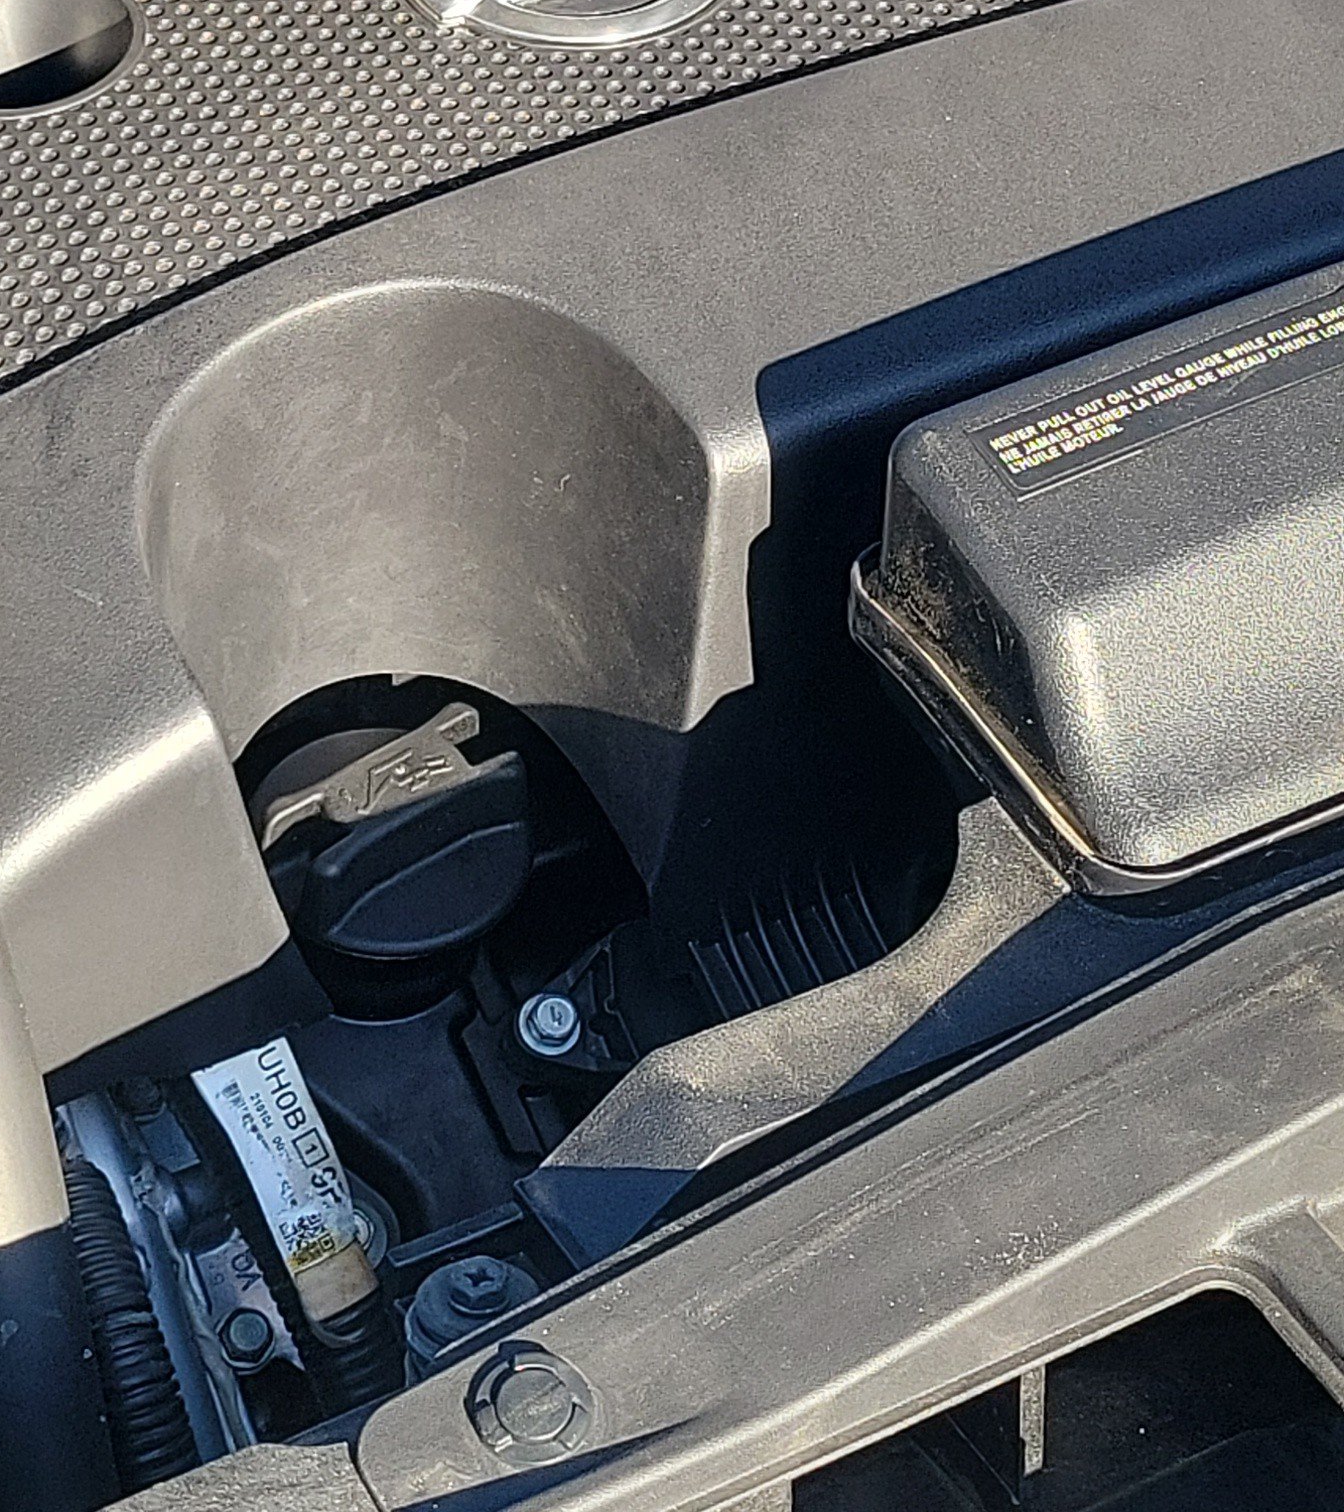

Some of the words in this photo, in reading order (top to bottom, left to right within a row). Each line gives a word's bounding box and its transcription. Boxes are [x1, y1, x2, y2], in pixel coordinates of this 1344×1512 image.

[989, 425, 1040, 452] NEVER
[1039, 411, 1076, 432] PULL
[1074, 400, 1106, 418] OUT
[1106, 389, 1133, 406] OIL
[1131, 372, 1177, 397] LEVEL
[1174, 351, 1225, 379] GAUGE
[1223, 336, 1269, 360] WHILE
[1267, 318, 1320, 344] FILLING
[998, 447, 1022, 464] NE
[1024, 429, 1075, 455] JAMAIS
[1072, 406, 1133, 436] RETIRER
[1131, 396, 1153, 412] LA
[1151, 381, 1198, 405] JAUGE
[1196, 371, 1218, 388] DE
[1216, 353, 1268, 379] NIVEAU
[1269, 332, 1322, 360] D'HUILE
[1007, 446, 1064, 474] L'HUILE
